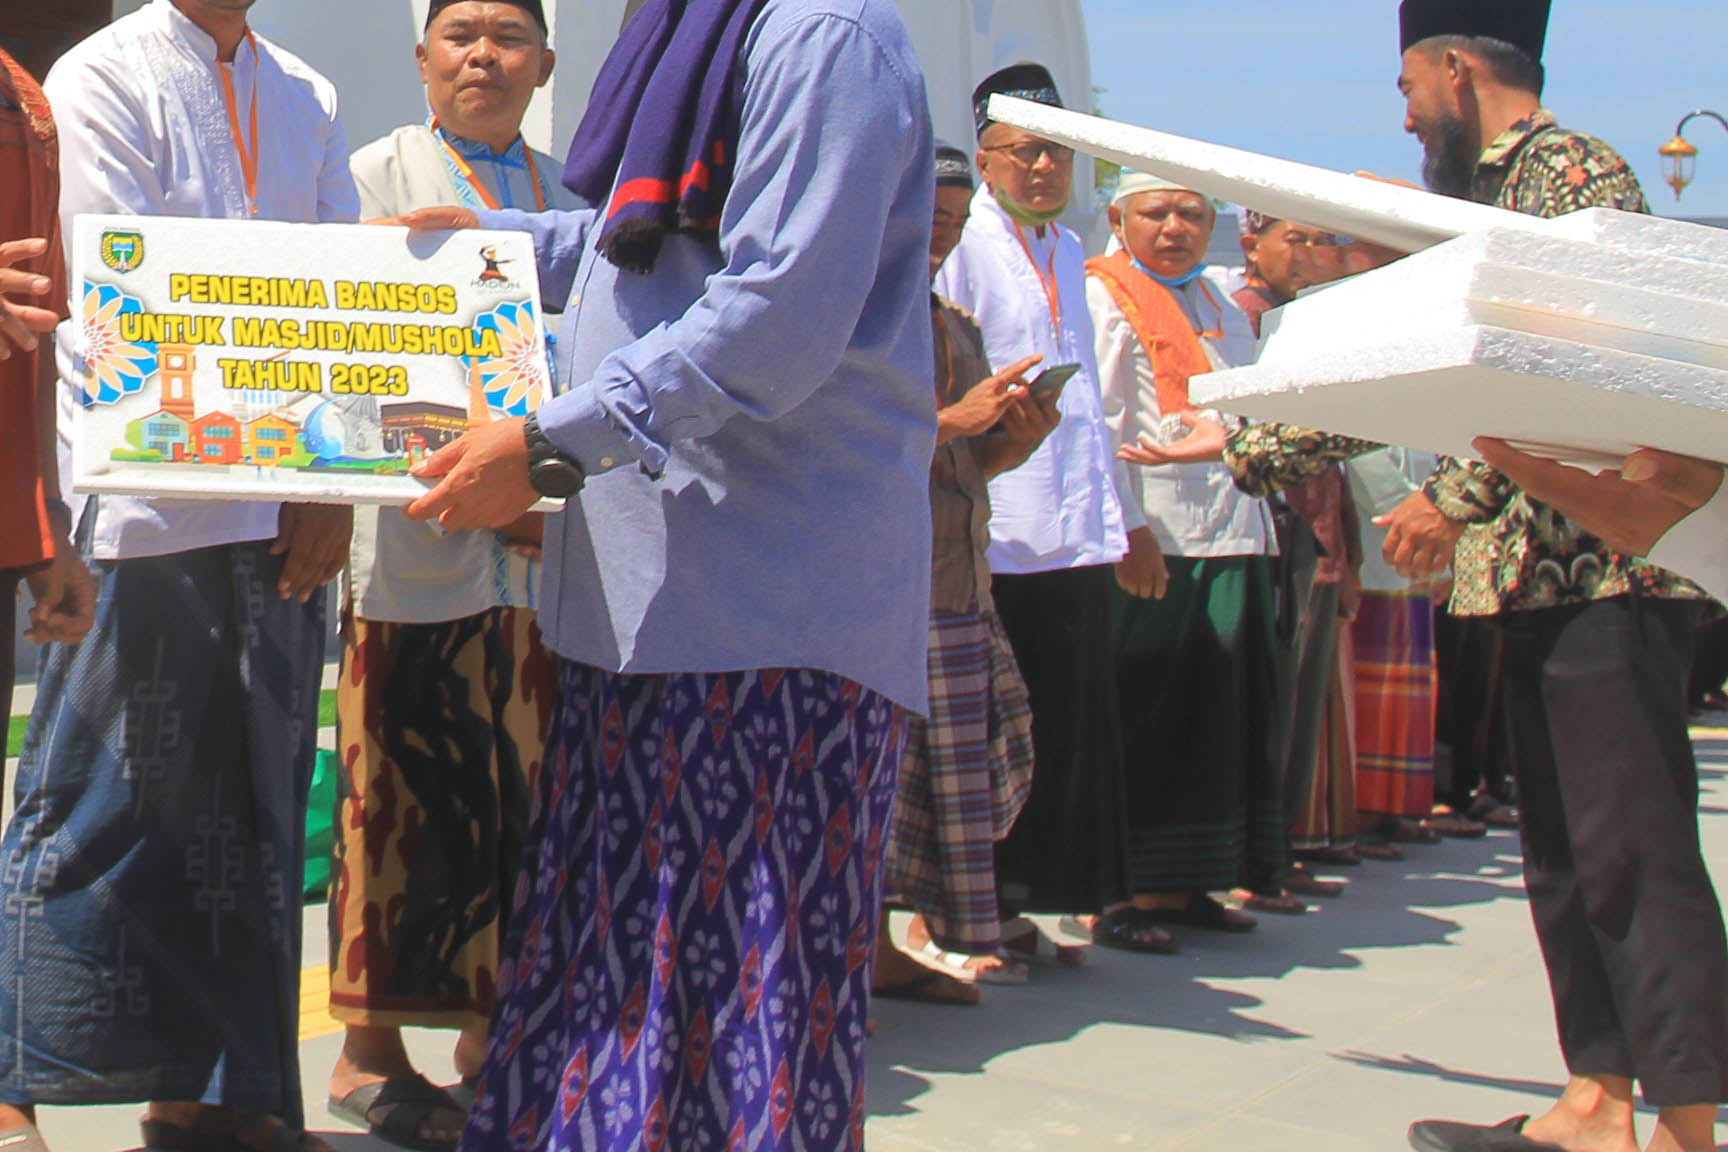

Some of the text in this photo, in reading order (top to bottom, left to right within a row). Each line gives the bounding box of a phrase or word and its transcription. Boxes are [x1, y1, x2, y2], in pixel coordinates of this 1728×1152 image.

[170, 273, 457, 314] PENERIMA BANSOS
[120, 312, 503, 357] UNTUK MASJID/MUSHOLA
[218, 359, 409, 396] TAHUN 2023
